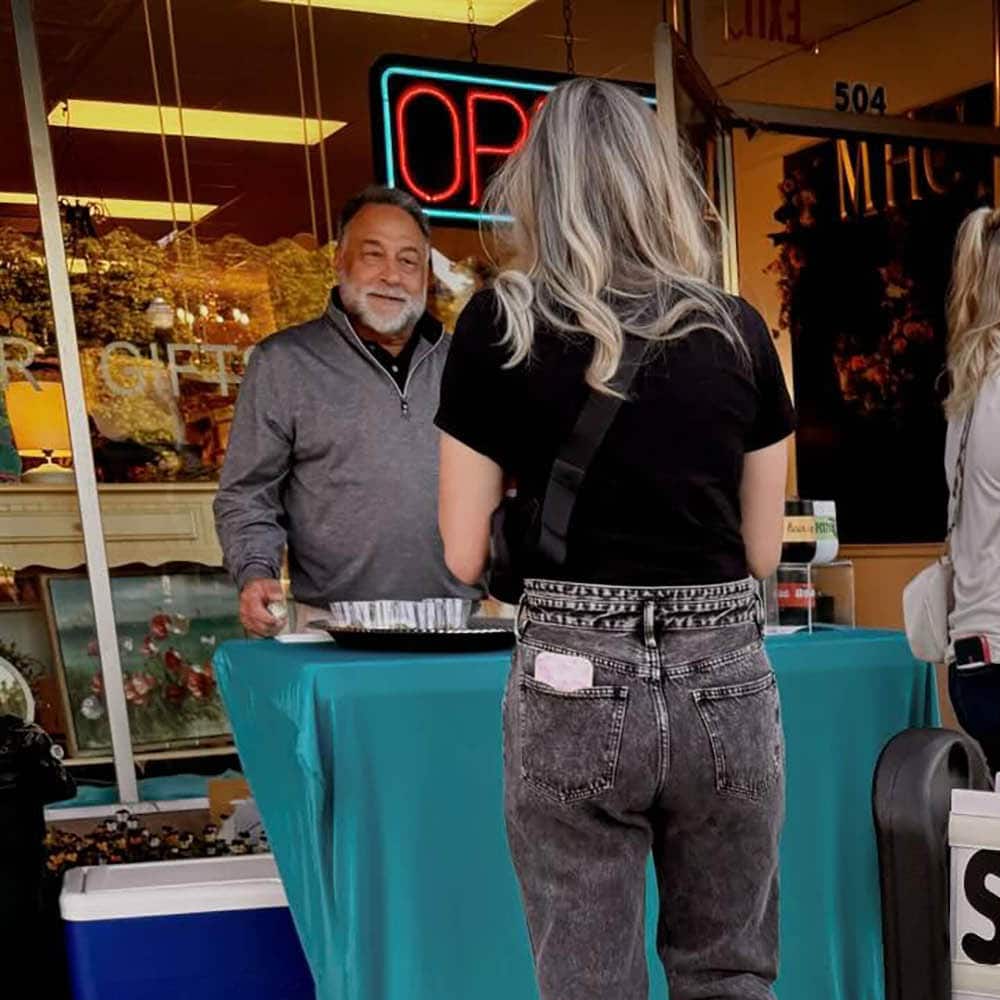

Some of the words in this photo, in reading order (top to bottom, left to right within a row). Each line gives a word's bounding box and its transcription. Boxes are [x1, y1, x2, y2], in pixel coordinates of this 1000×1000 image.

[834, 81, 888, 115] 504
[396, 82, 549, 206] OP
[101, 341, 254, 397] GIFT
